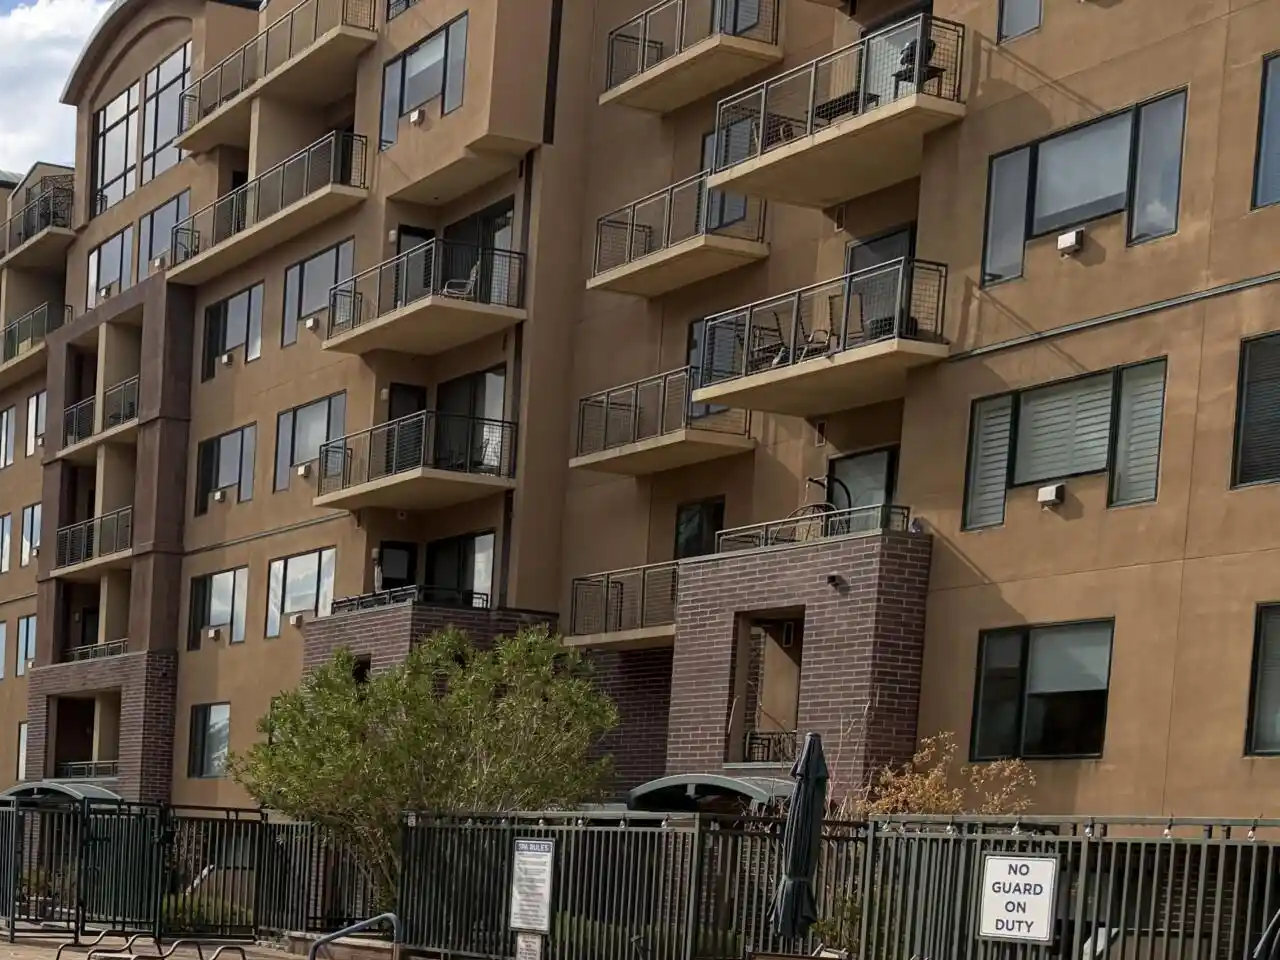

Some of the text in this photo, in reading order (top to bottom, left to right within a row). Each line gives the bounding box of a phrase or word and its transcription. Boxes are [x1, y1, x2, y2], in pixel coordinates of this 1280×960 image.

[517, 843, 549, 852] SPA RULES
[1007, 863, 1030, 876] NO
[991, 881, 1044, 896] GUARD
[1004, 901, 1027, 914] ON
[995, 918, 1034, 933] DUTY
